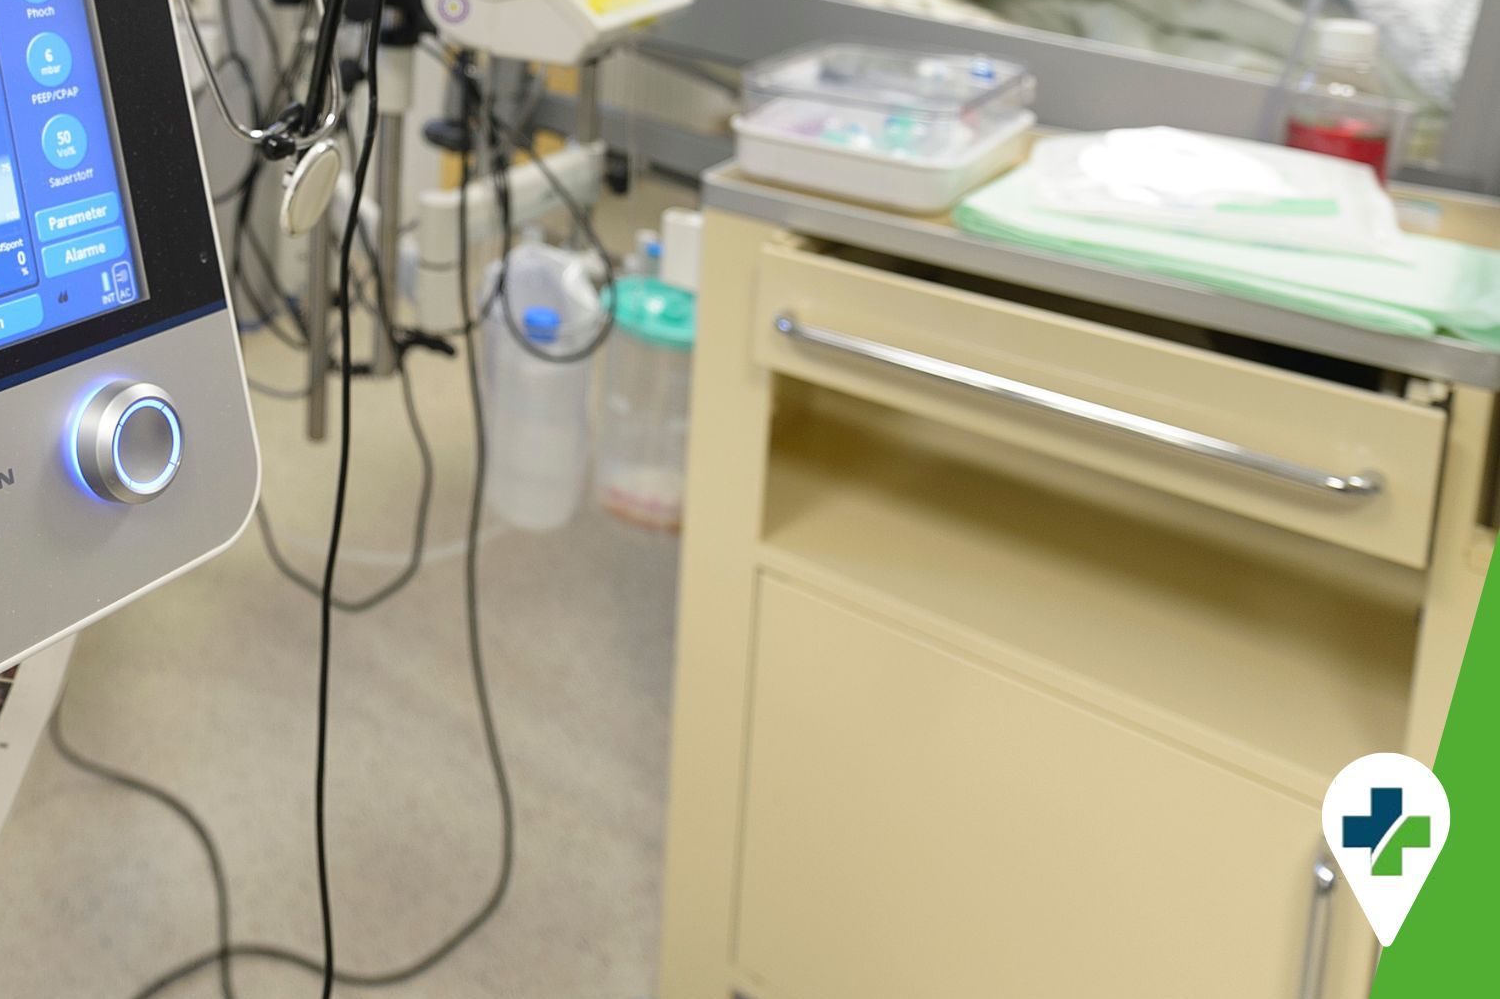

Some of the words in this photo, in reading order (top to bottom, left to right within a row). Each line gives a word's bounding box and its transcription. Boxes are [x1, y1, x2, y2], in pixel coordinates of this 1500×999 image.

[27, 5, 55, 19] Phoch
[45, 48, 53, 63] 6
[41, 64, 61, 76] mbar
[31, 86, 79, 105] PEEP/CPAP
[57, 130, 71, 146] 50
[57, 145, 76, 157] Vol%
[49, 168, 94, 188] Sauerstoff
[48, 205, 108, 231] Parameter
[17, 250, 26, 265] 0
[65, 243, 106, 264] Alarme
